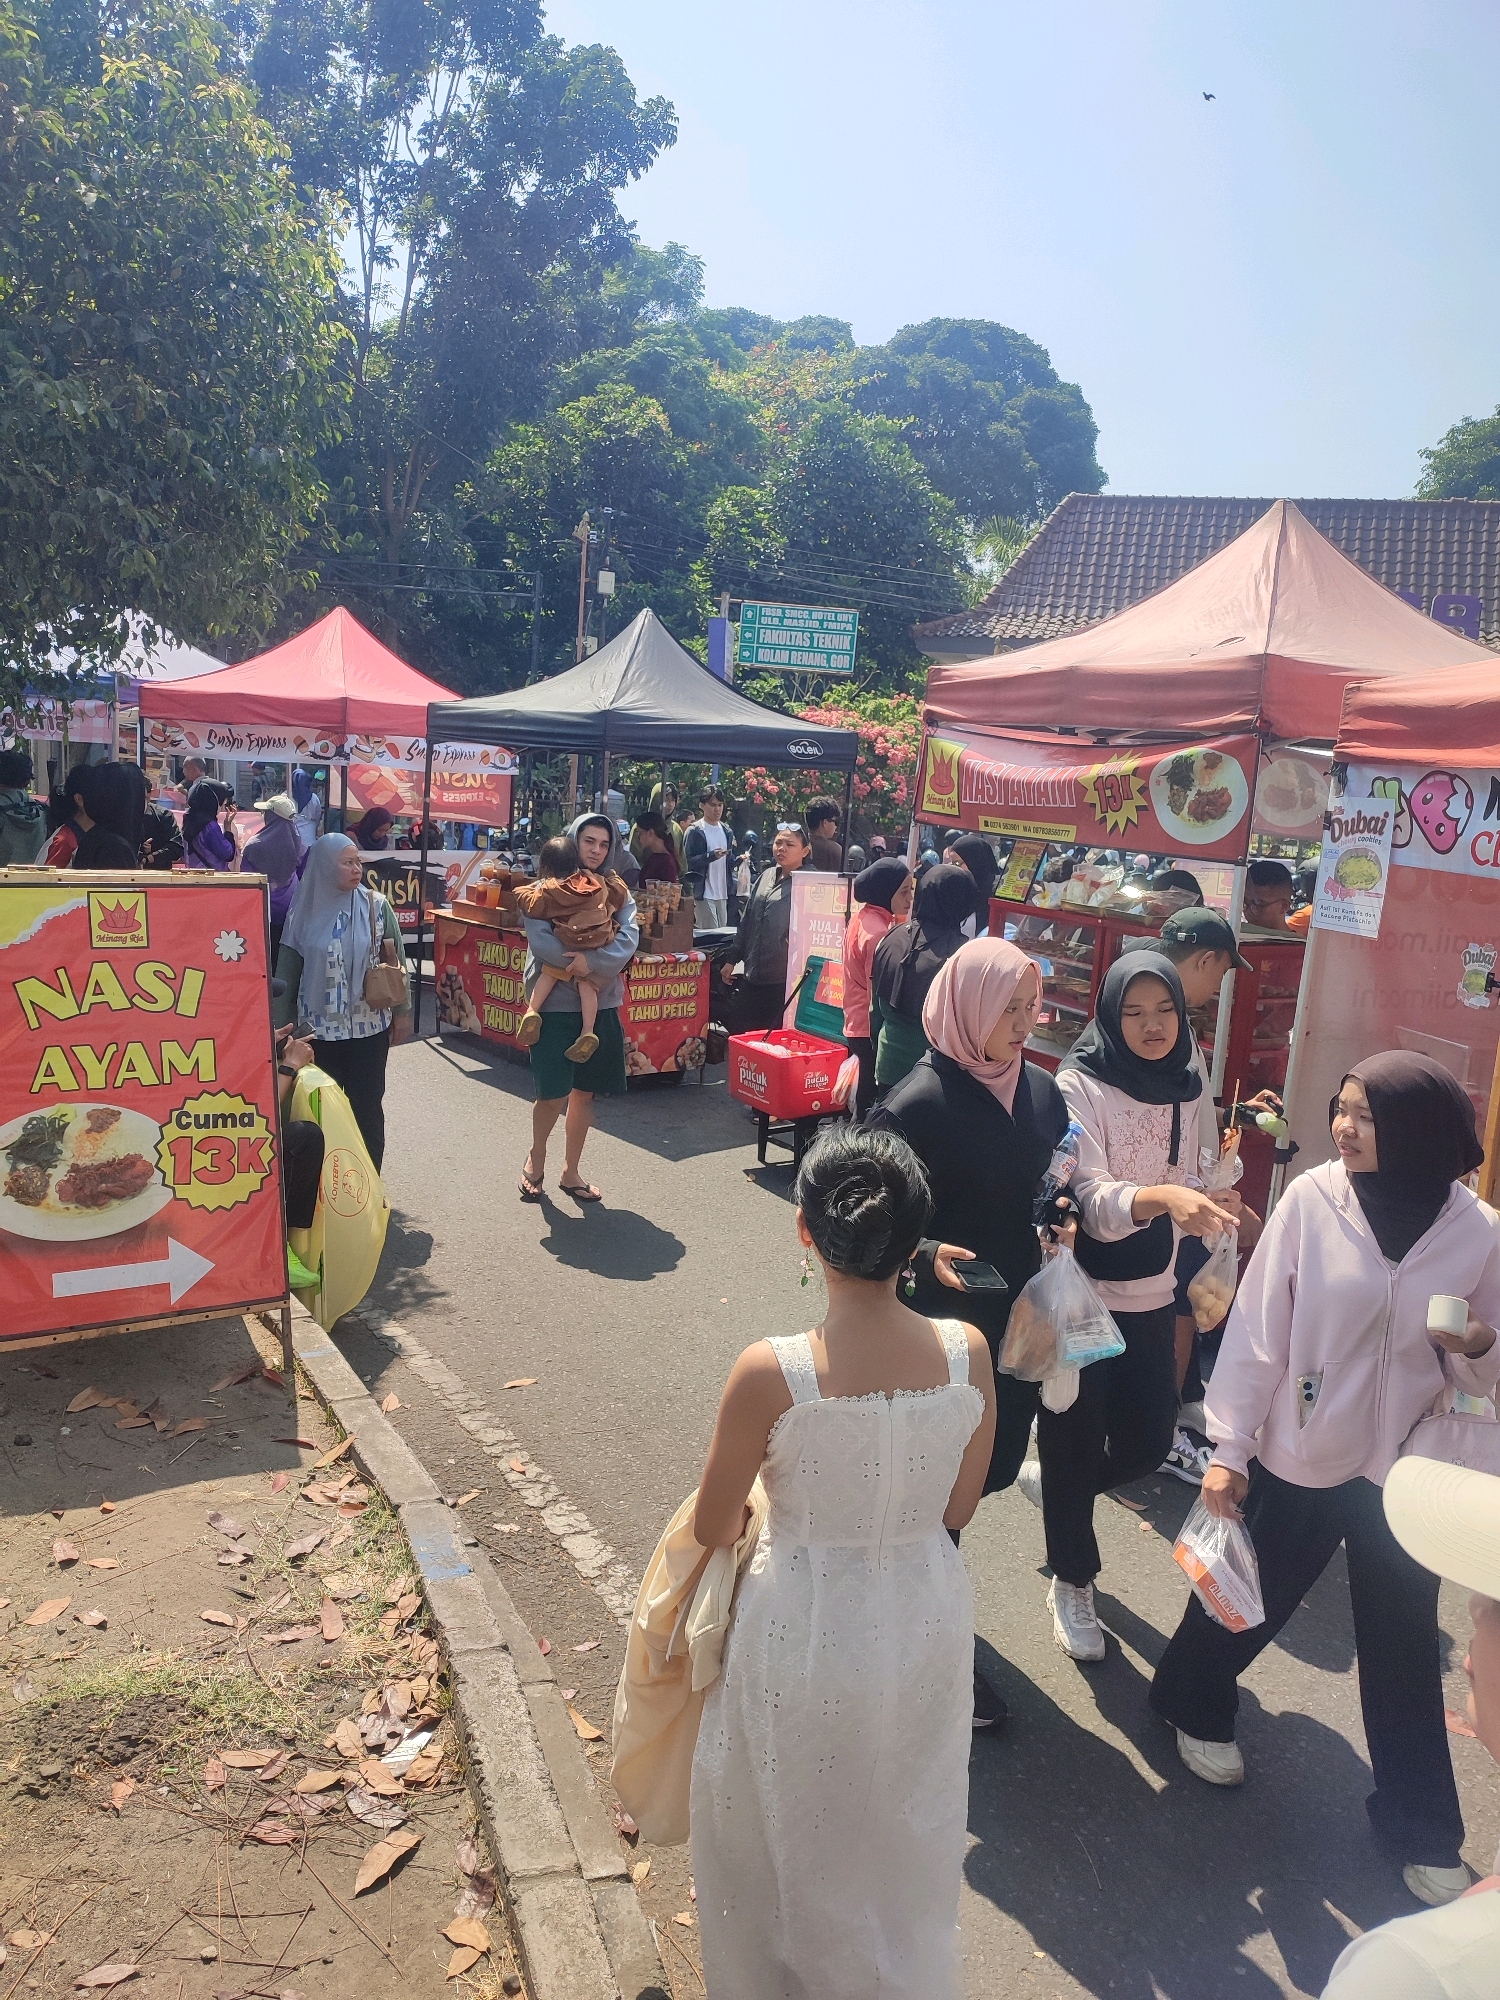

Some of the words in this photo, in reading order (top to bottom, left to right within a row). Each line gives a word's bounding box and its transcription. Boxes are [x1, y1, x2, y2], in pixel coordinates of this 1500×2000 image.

[812, 611, 835, 621] HOTEL
[823, 621, 853, 631] FMIPA
[759, 629, 811, 647] FAKULTAS
[813, 632, 852, 650] TEKNIK
[757, 648, 789, 664] KOLAM
[830, 653, 850, 669] GOR
[204, 728, 244, 752] Sushi
[245, 732, 287, 756] Express
[961, 758, 1008, 805] NASI
[1093, 773, 1134, 815] 13K
[1022, 825, 1032, 833] WA
[1330, 809, 1390, 843] Dubai
[366, 869, 420, 906] Sush
[95, 934, 128, 945] Minang
[477, 940, 509, 970] TAHU
[1463, 948, 1497, 967] Dubai
[630, 963, 656, 980] AHU
[658, 961, 703, 979] GEJROT
[13, 959, 206, 1031] NASI
[482, 972, 515, 1003] TAHU
[629, 984, 661, 1001] TAHU
[663, 981, 698, 999] PONG
[482, 1002, 514, 1034] TAHU
[628, 1003, 661, 1022] TAHU
[663, 1001, 697, 1019] PETIS
[29, 1037, 217, 1094] AYAM
[740, 1067, 768, 1088] pucuk
[175, 1110, 255, 1130] Cuma
[167, 1135, 271, 1186] 13K
[1208, 1583, 1241, 1621] ALMAZ
